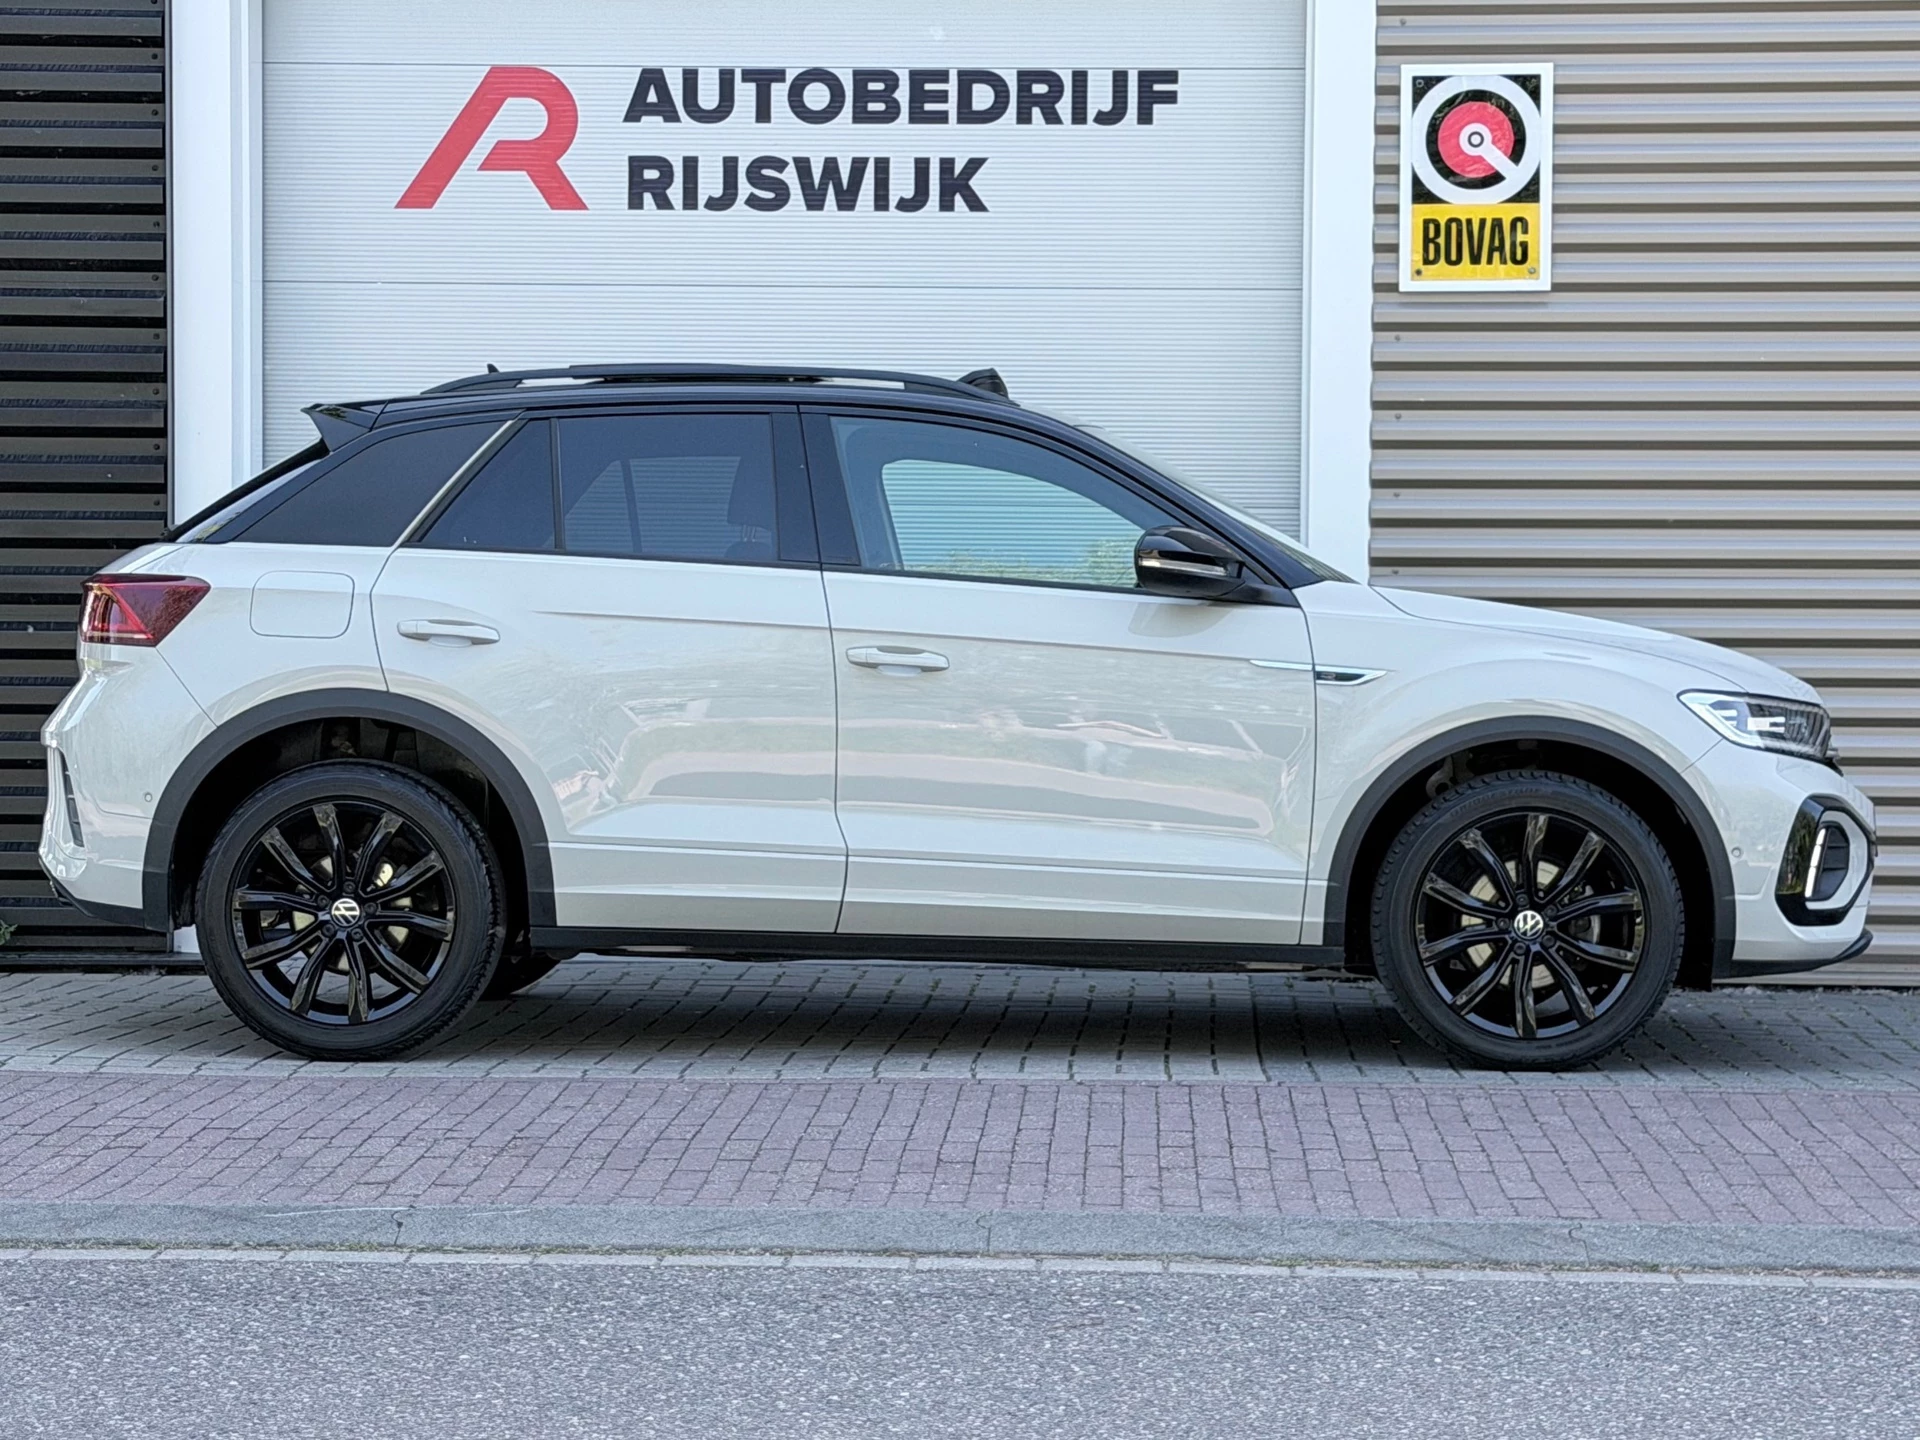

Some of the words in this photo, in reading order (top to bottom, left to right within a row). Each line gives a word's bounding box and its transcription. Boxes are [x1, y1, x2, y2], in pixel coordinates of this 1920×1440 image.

[622, 67, 1179, 126] AUTOBEDRIJF
[627, 155, 990, 213] RIJSWIJK
[1422, 216, 1529, 266] BOVAG
